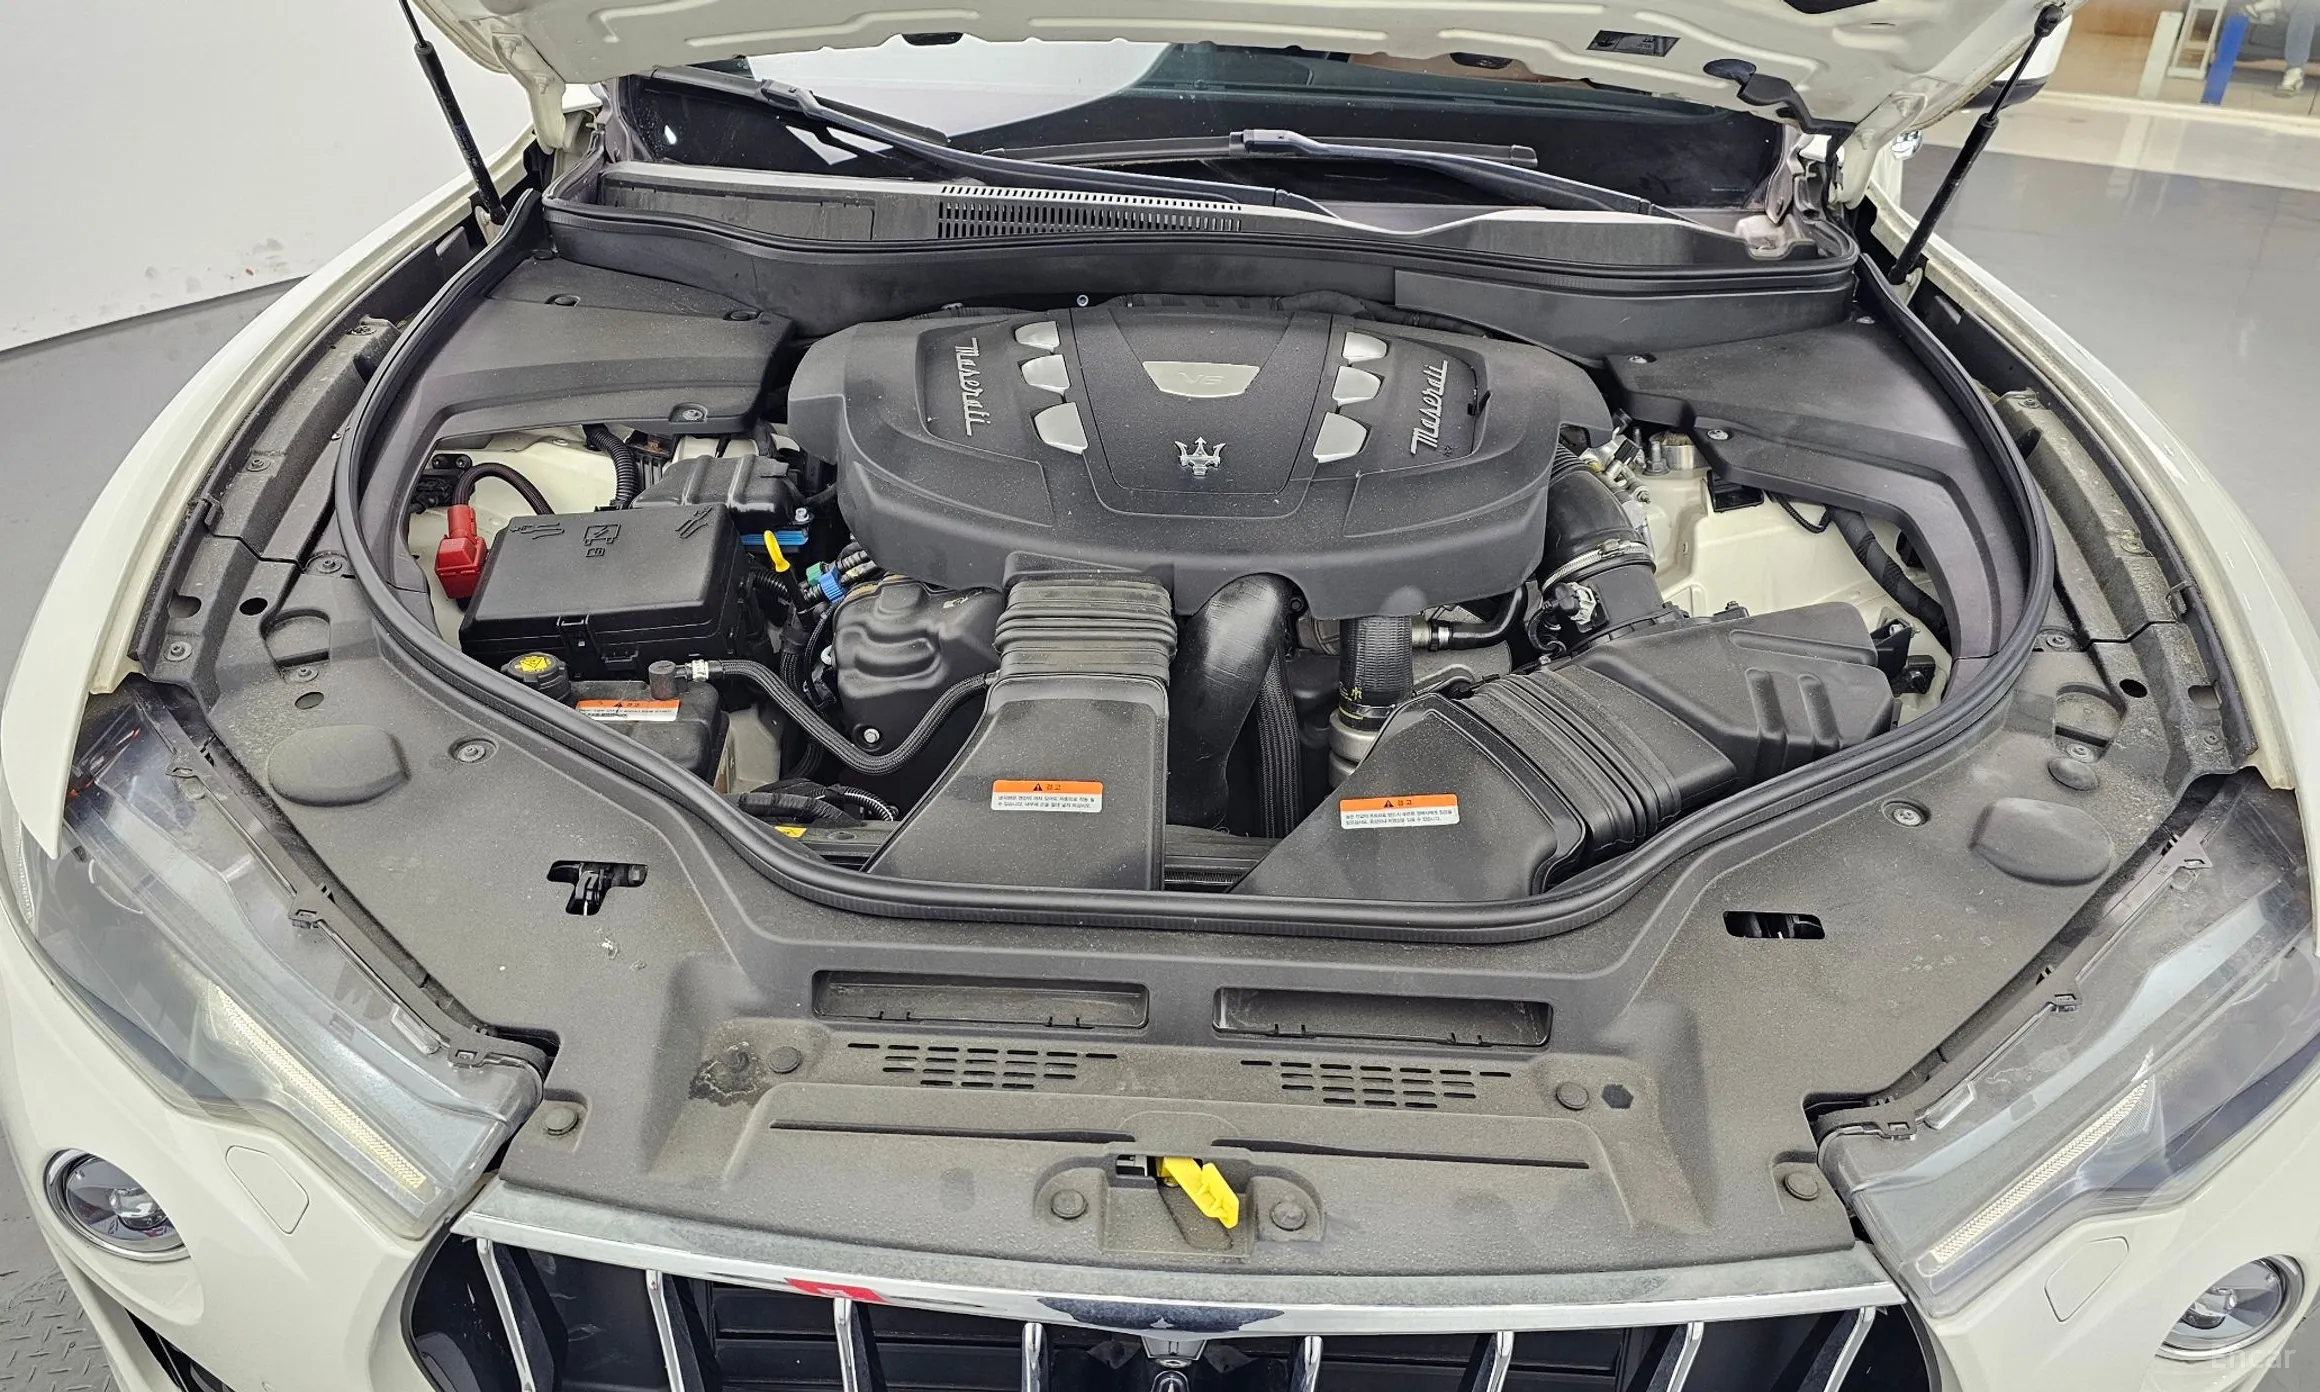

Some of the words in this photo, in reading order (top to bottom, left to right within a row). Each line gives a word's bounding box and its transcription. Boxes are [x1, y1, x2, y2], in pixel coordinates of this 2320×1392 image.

[954, 337, 991, 436] Maserati
[1177, 371, 1225, 385] V6
[1410, 359, 1448, 455] Maserati
